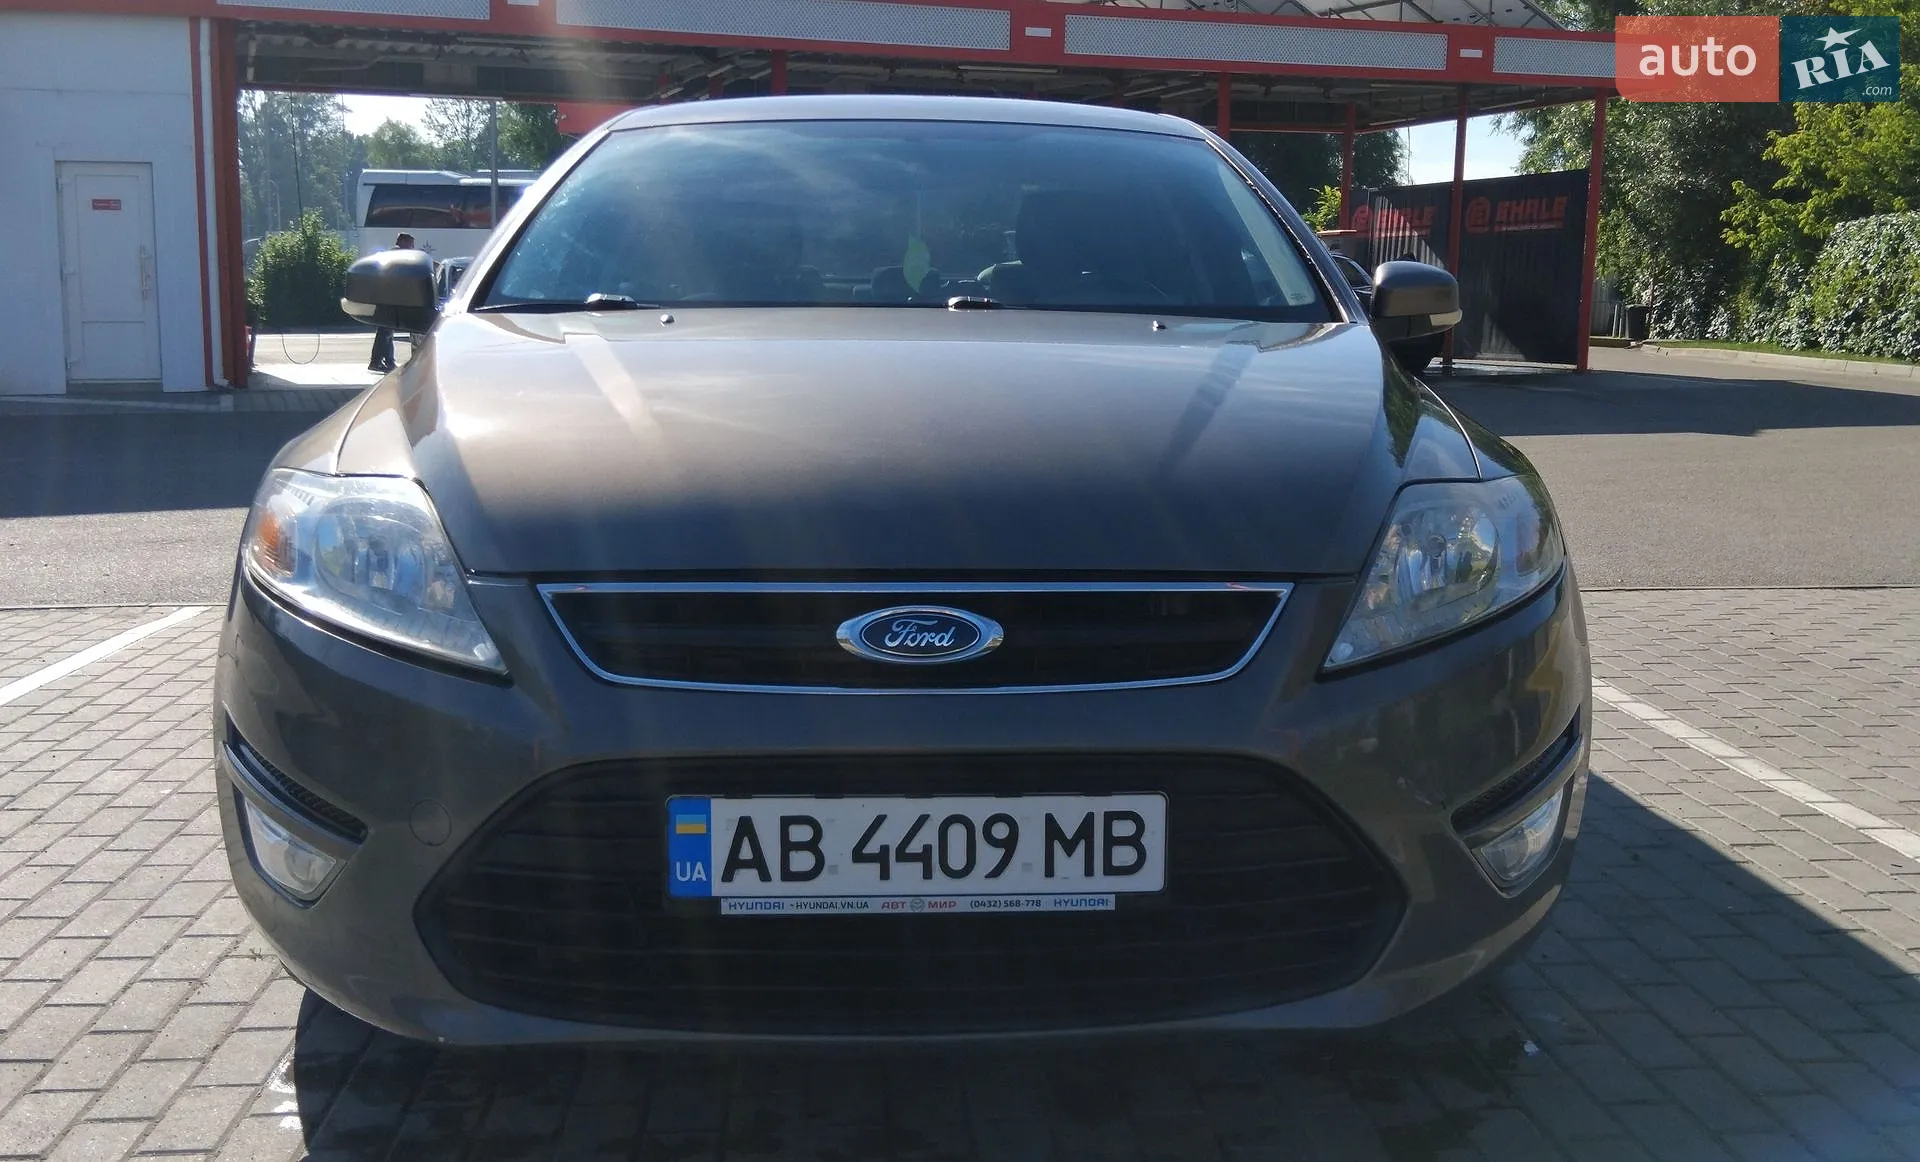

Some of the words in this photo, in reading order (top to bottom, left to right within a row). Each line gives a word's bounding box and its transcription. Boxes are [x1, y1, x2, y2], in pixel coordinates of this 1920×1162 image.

[884, 619, 955, 647] Ford
[721, 815, 825, 883] AB
[852, 813, 1019, 881] 4409
[1043, 810, 1148, 878] MB
[676, 862, 707, 881] UA
[728, 902, 785, 911] HYUNDAI
[928, 900, 957, 909] МИР
[970, 899, 1001, 909] (0432)
[1003, 899, 1042, 908] 568-778
[1053, 898, 1109, 908] HYUNDAI
